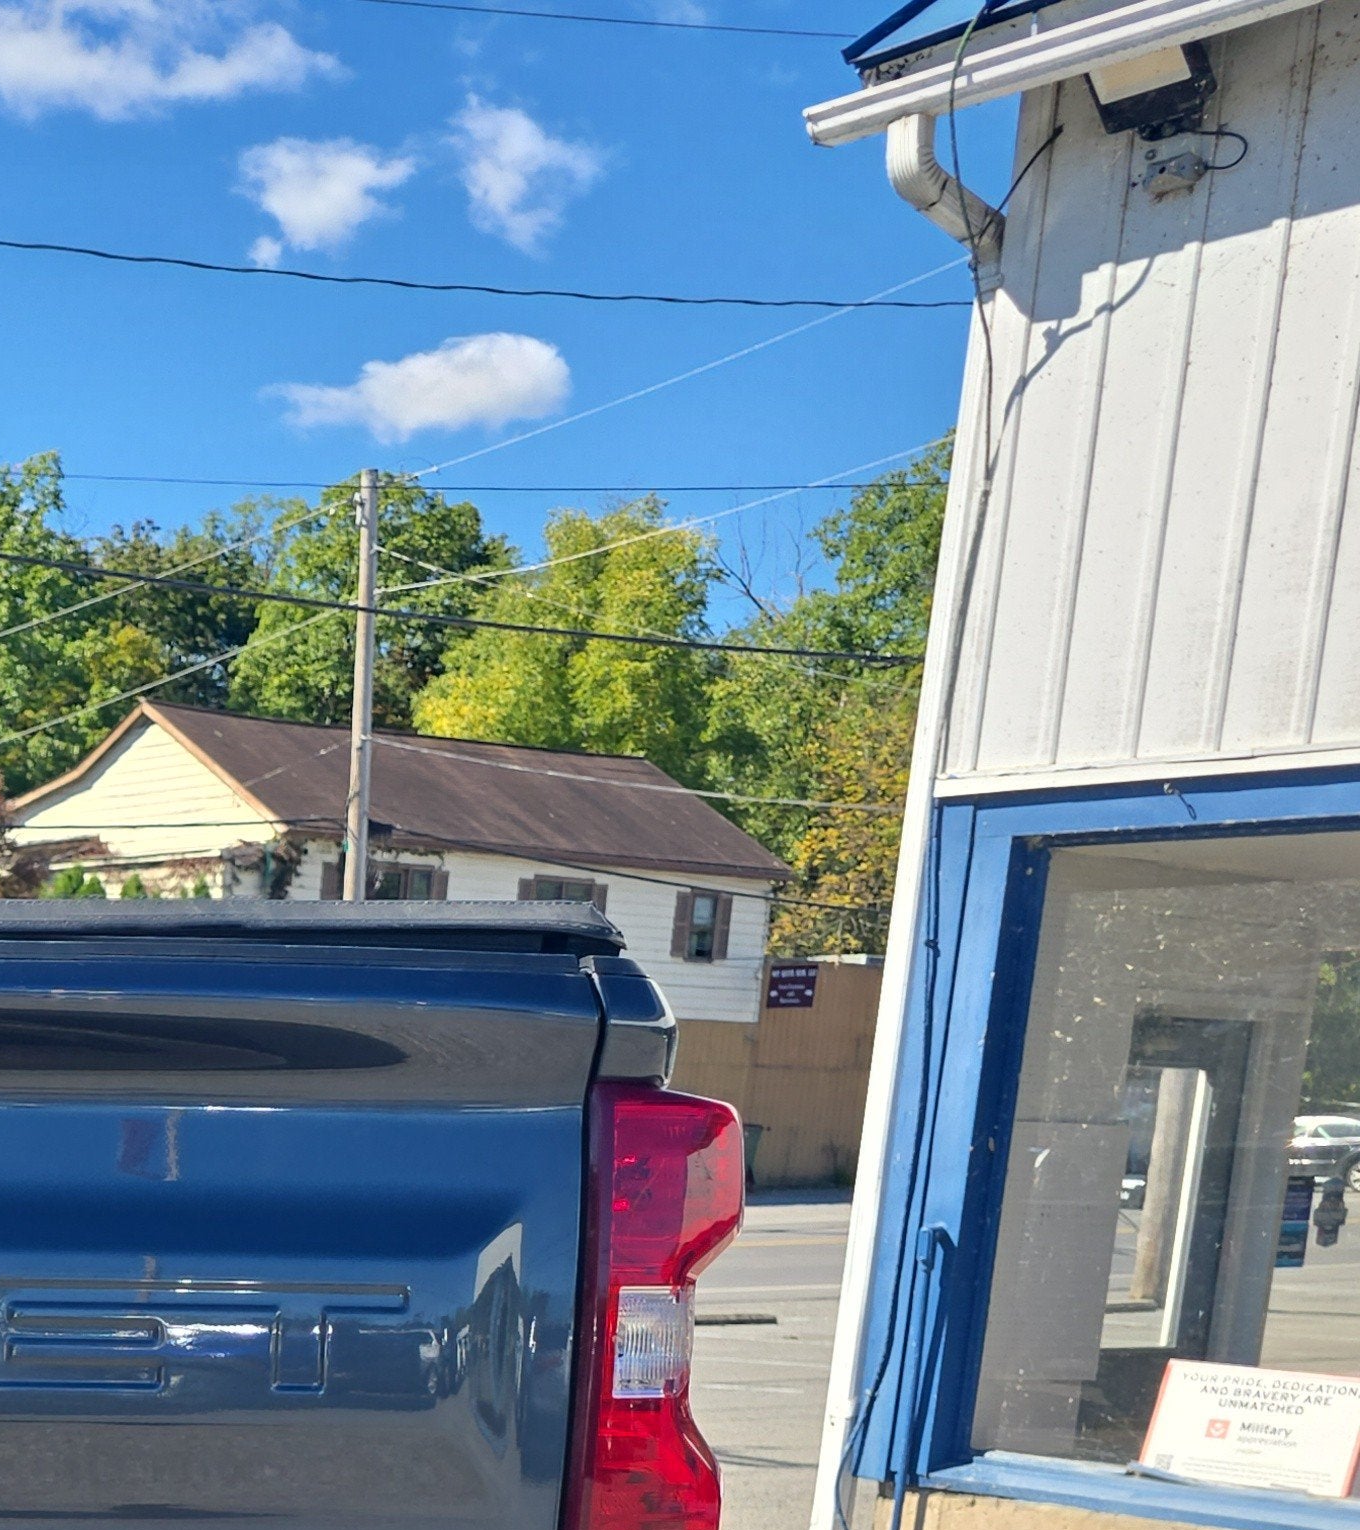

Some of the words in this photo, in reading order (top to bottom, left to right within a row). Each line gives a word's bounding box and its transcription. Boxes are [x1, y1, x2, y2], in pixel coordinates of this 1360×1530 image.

[1233, 1388, 1300, 1402] BRAVERY
[1303, 1394, 1333, 1407] ARE
[1218, 1398, 1305, 1416] UNMATCHED
[1240, 1421, 1293, 1439] Military
